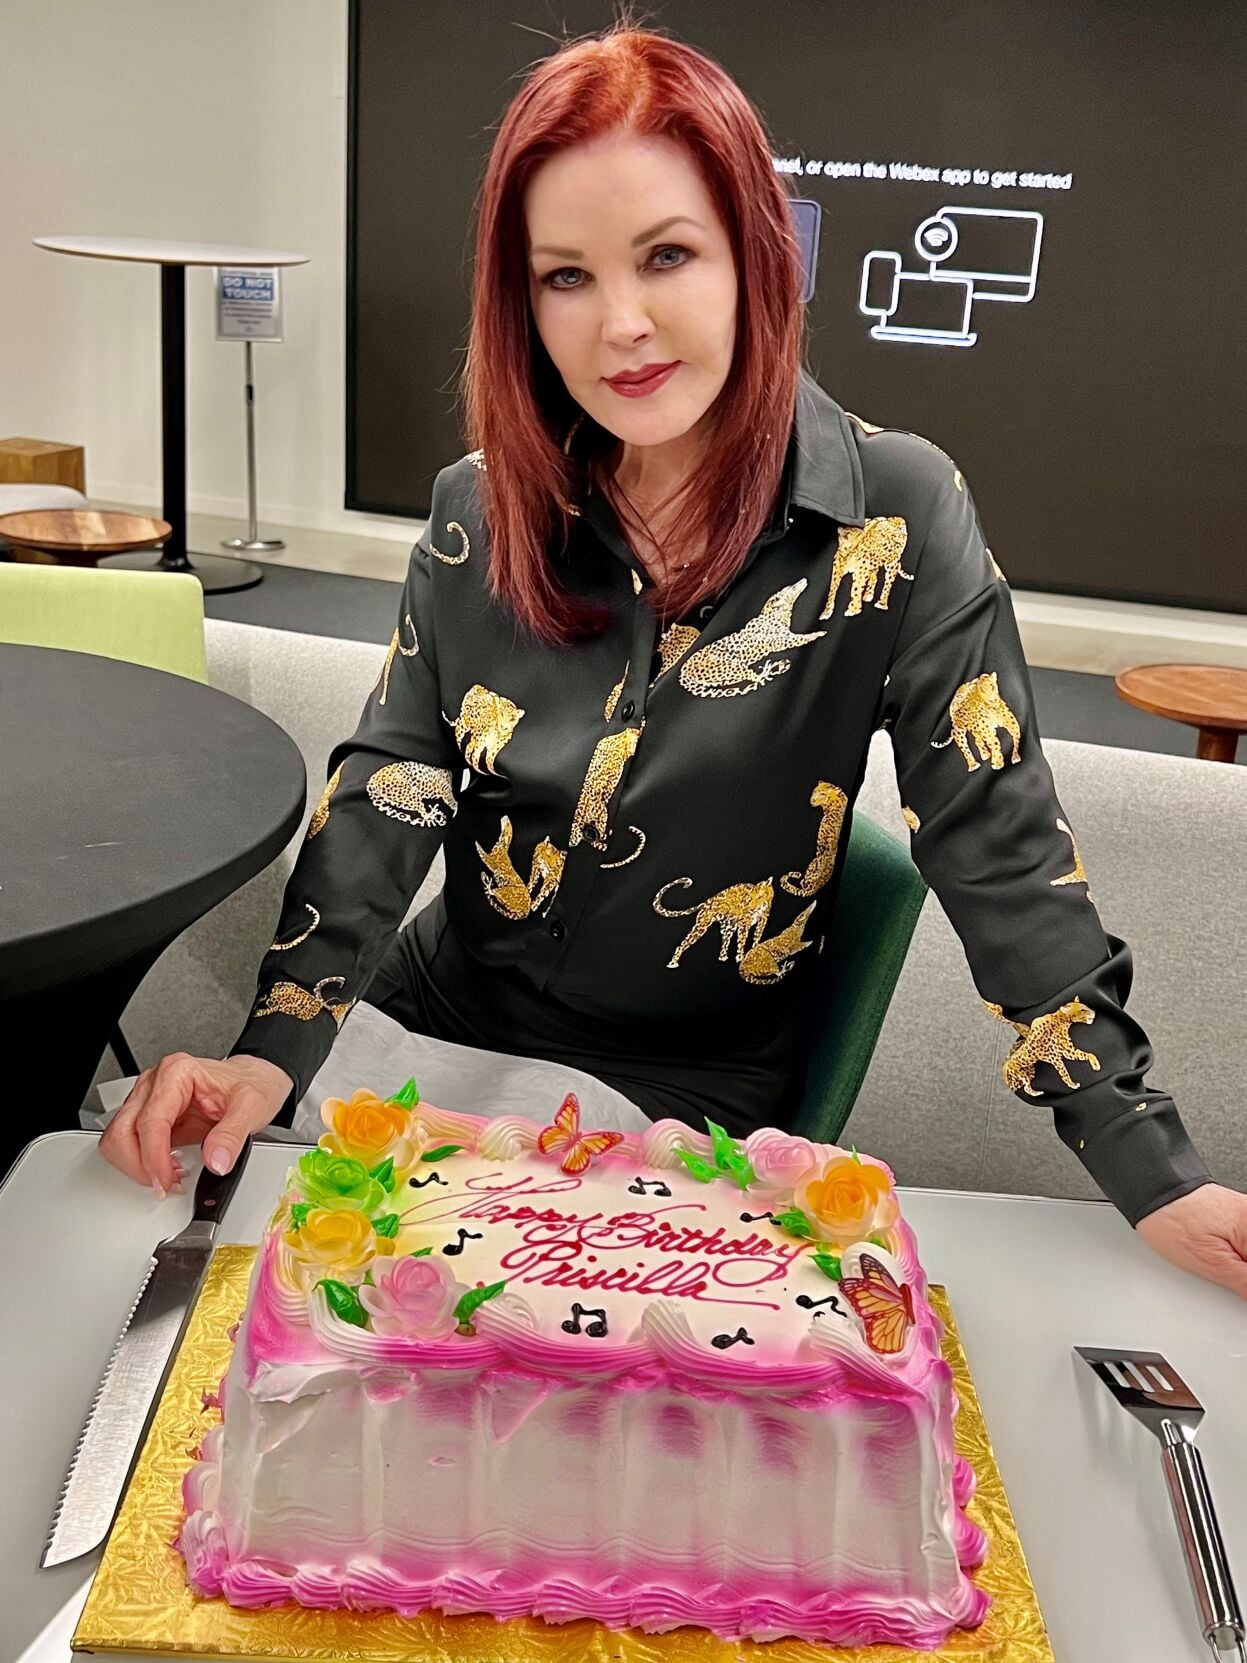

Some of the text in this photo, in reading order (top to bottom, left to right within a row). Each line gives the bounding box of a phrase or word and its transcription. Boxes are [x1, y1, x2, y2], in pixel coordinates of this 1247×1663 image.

[806, 160, 823, 175] or
[824, 161, 861, 179] open
[863, 161, 887, 179] the
[889, 161, 940, 181] Webex
[942, 168, 971, 186] app
[973, 168, 990, 185] to
[991, 171, 1018, 188] get
[1019, 172, 1073, 190] started
[223, 277, 273, 289] DO NOT
[224, 287, 272, 299] TOUCH
[399, 1172, 814, 1288] Happy Birthday
[499, 1240, 781, 1311] Priscilla
